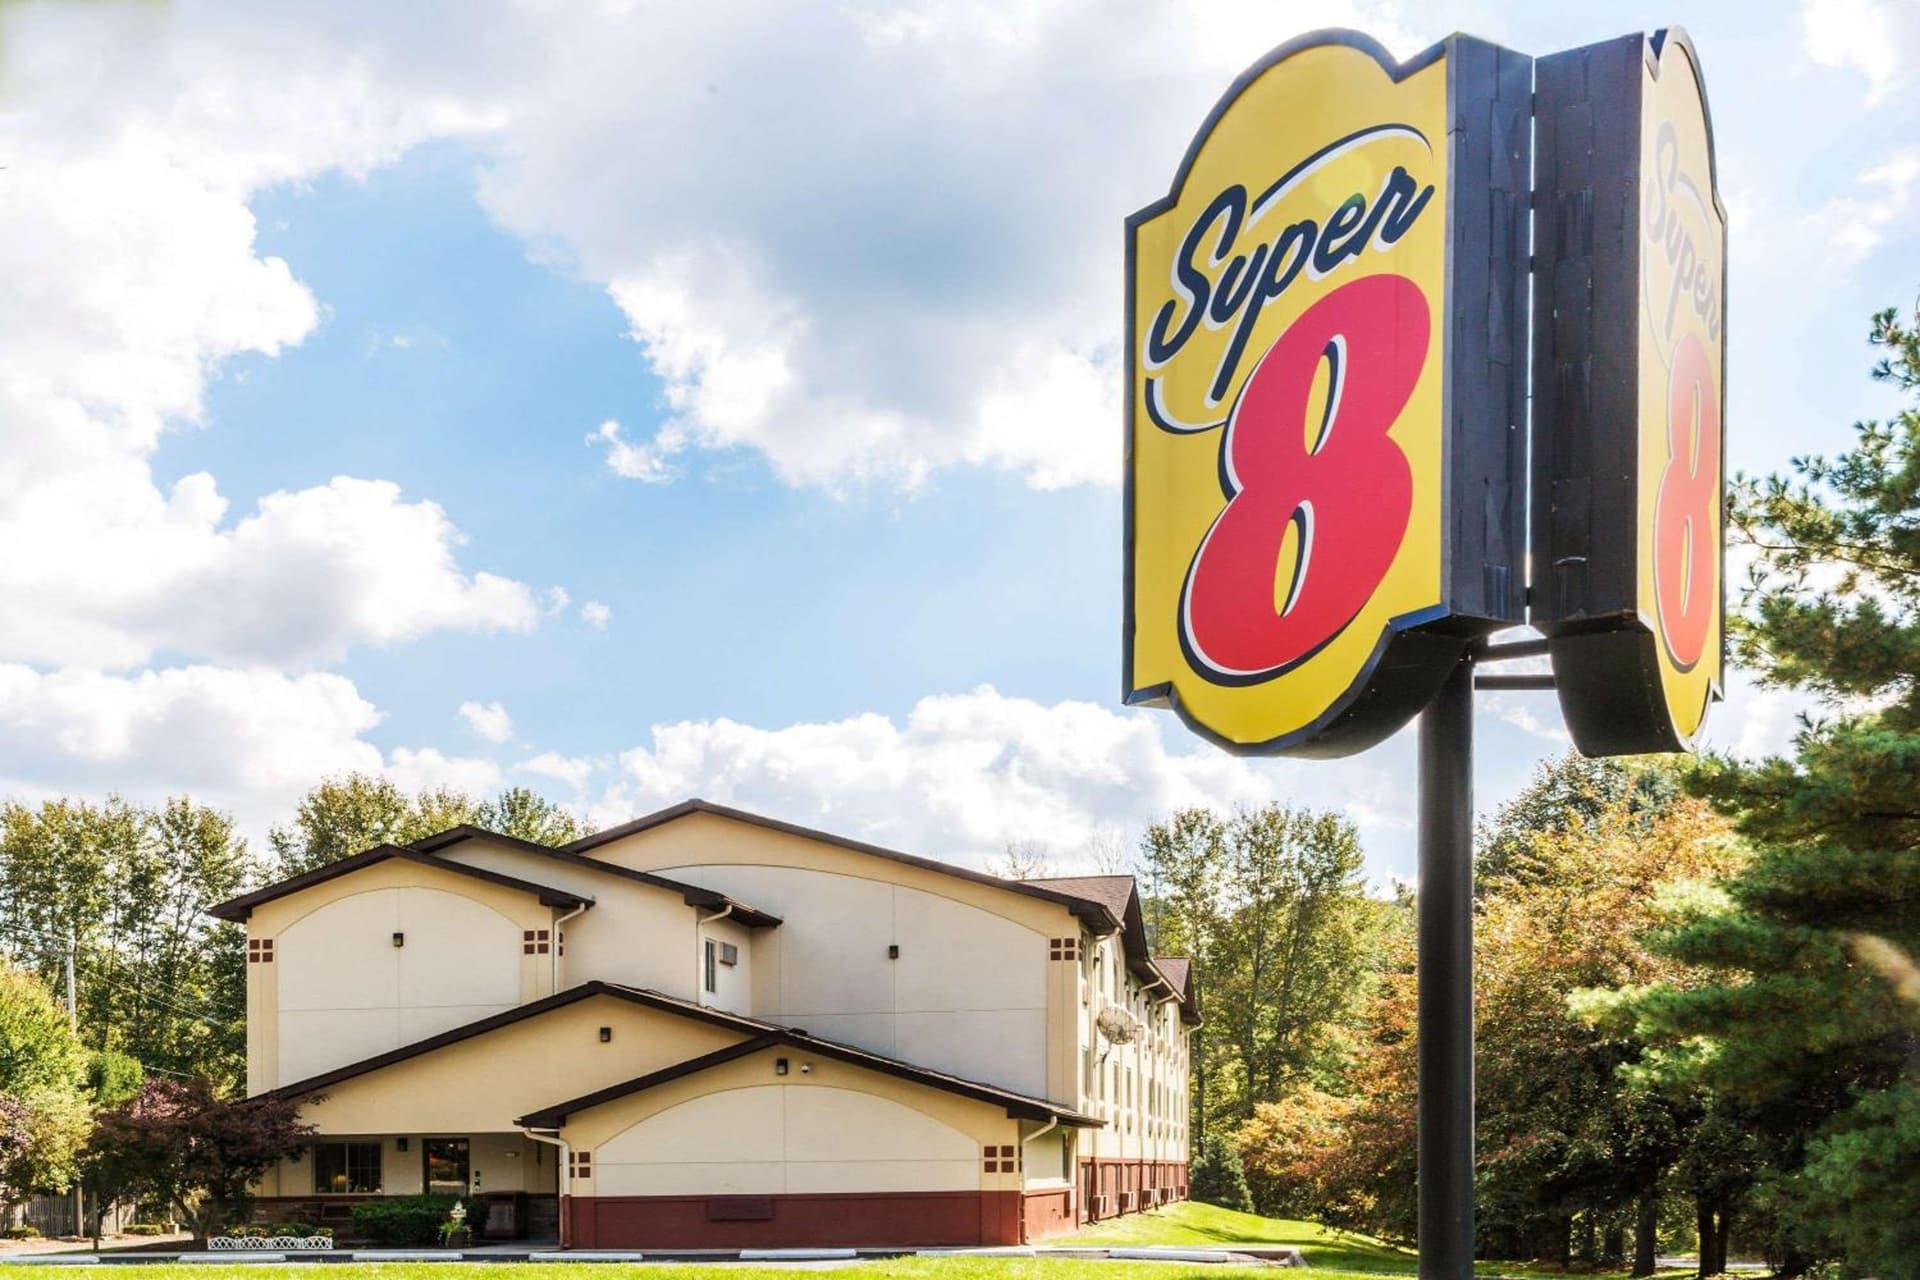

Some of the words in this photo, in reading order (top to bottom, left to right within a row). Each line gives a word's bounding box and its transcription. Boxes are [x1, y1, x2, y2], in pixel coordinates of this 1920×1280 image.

[1146, 166, 1435, 404] Super
[1645, 120, 1719, 342] Super
[1178, 273, 1431, 687] 8
[1654, 332, 1719, 673] 8
